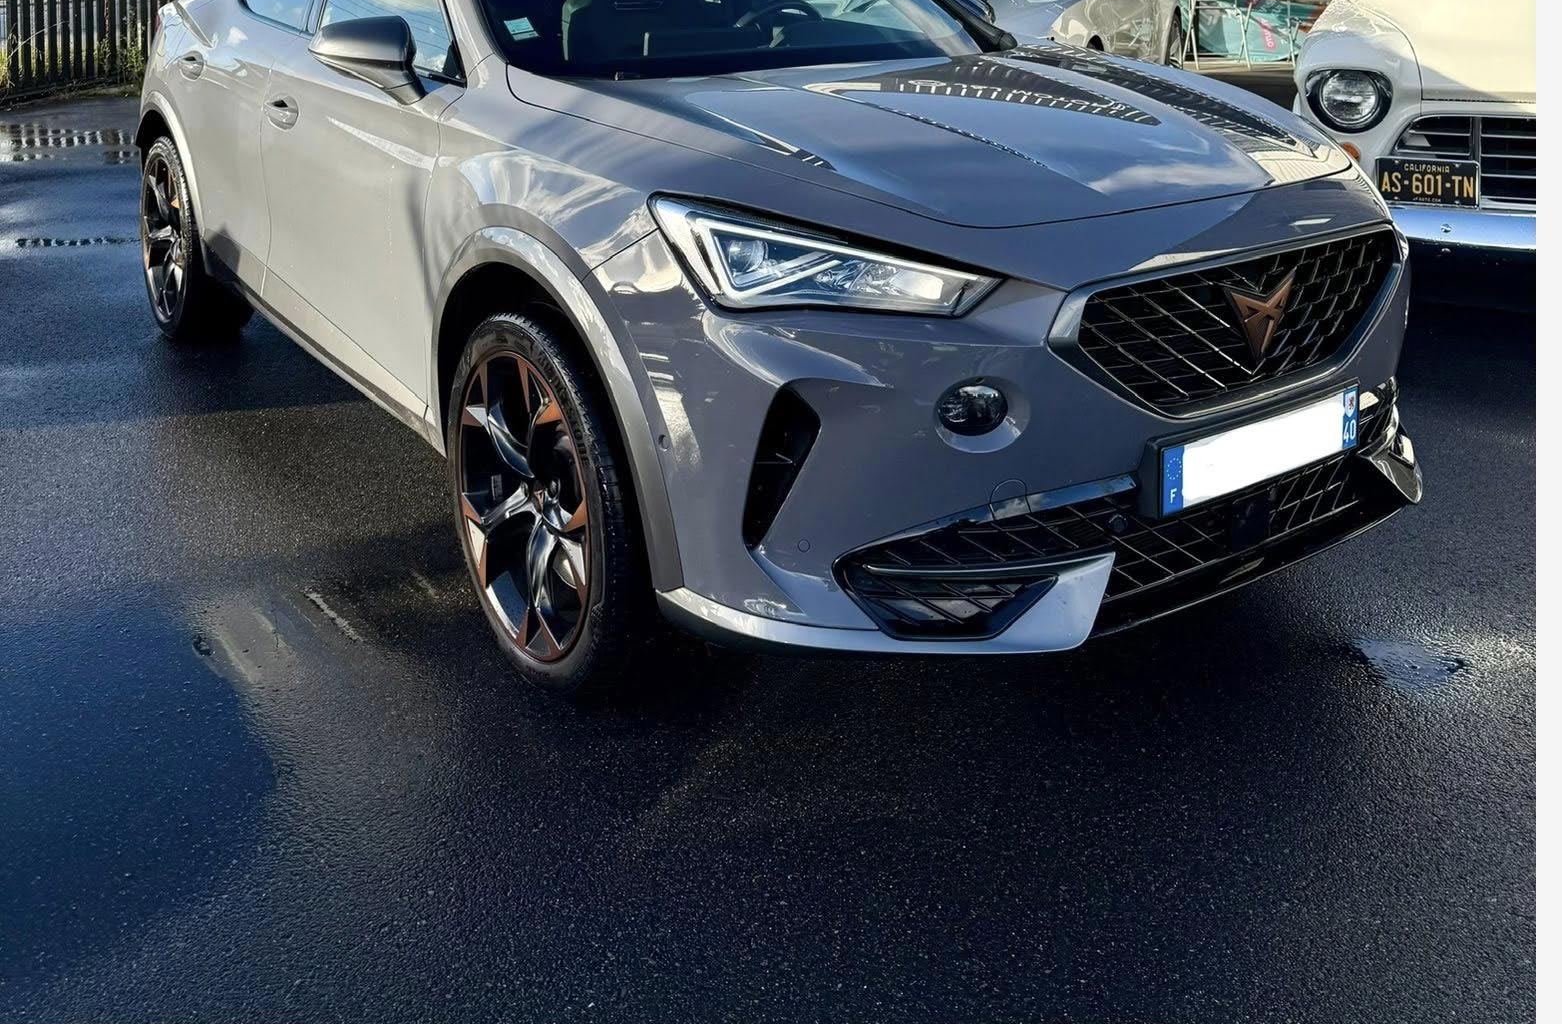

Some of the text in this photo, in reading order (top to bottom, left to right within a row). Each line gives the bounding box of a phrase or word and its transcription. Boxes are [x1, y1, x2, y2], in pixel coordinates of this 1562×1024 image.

[1404, 163, 1450, 173] CALIFORNIA
[1381, 171, 1474, 198] AS-601-TN
[1343, 419, 1357, 443] 40
[1170, 487, 1178, 504] F
